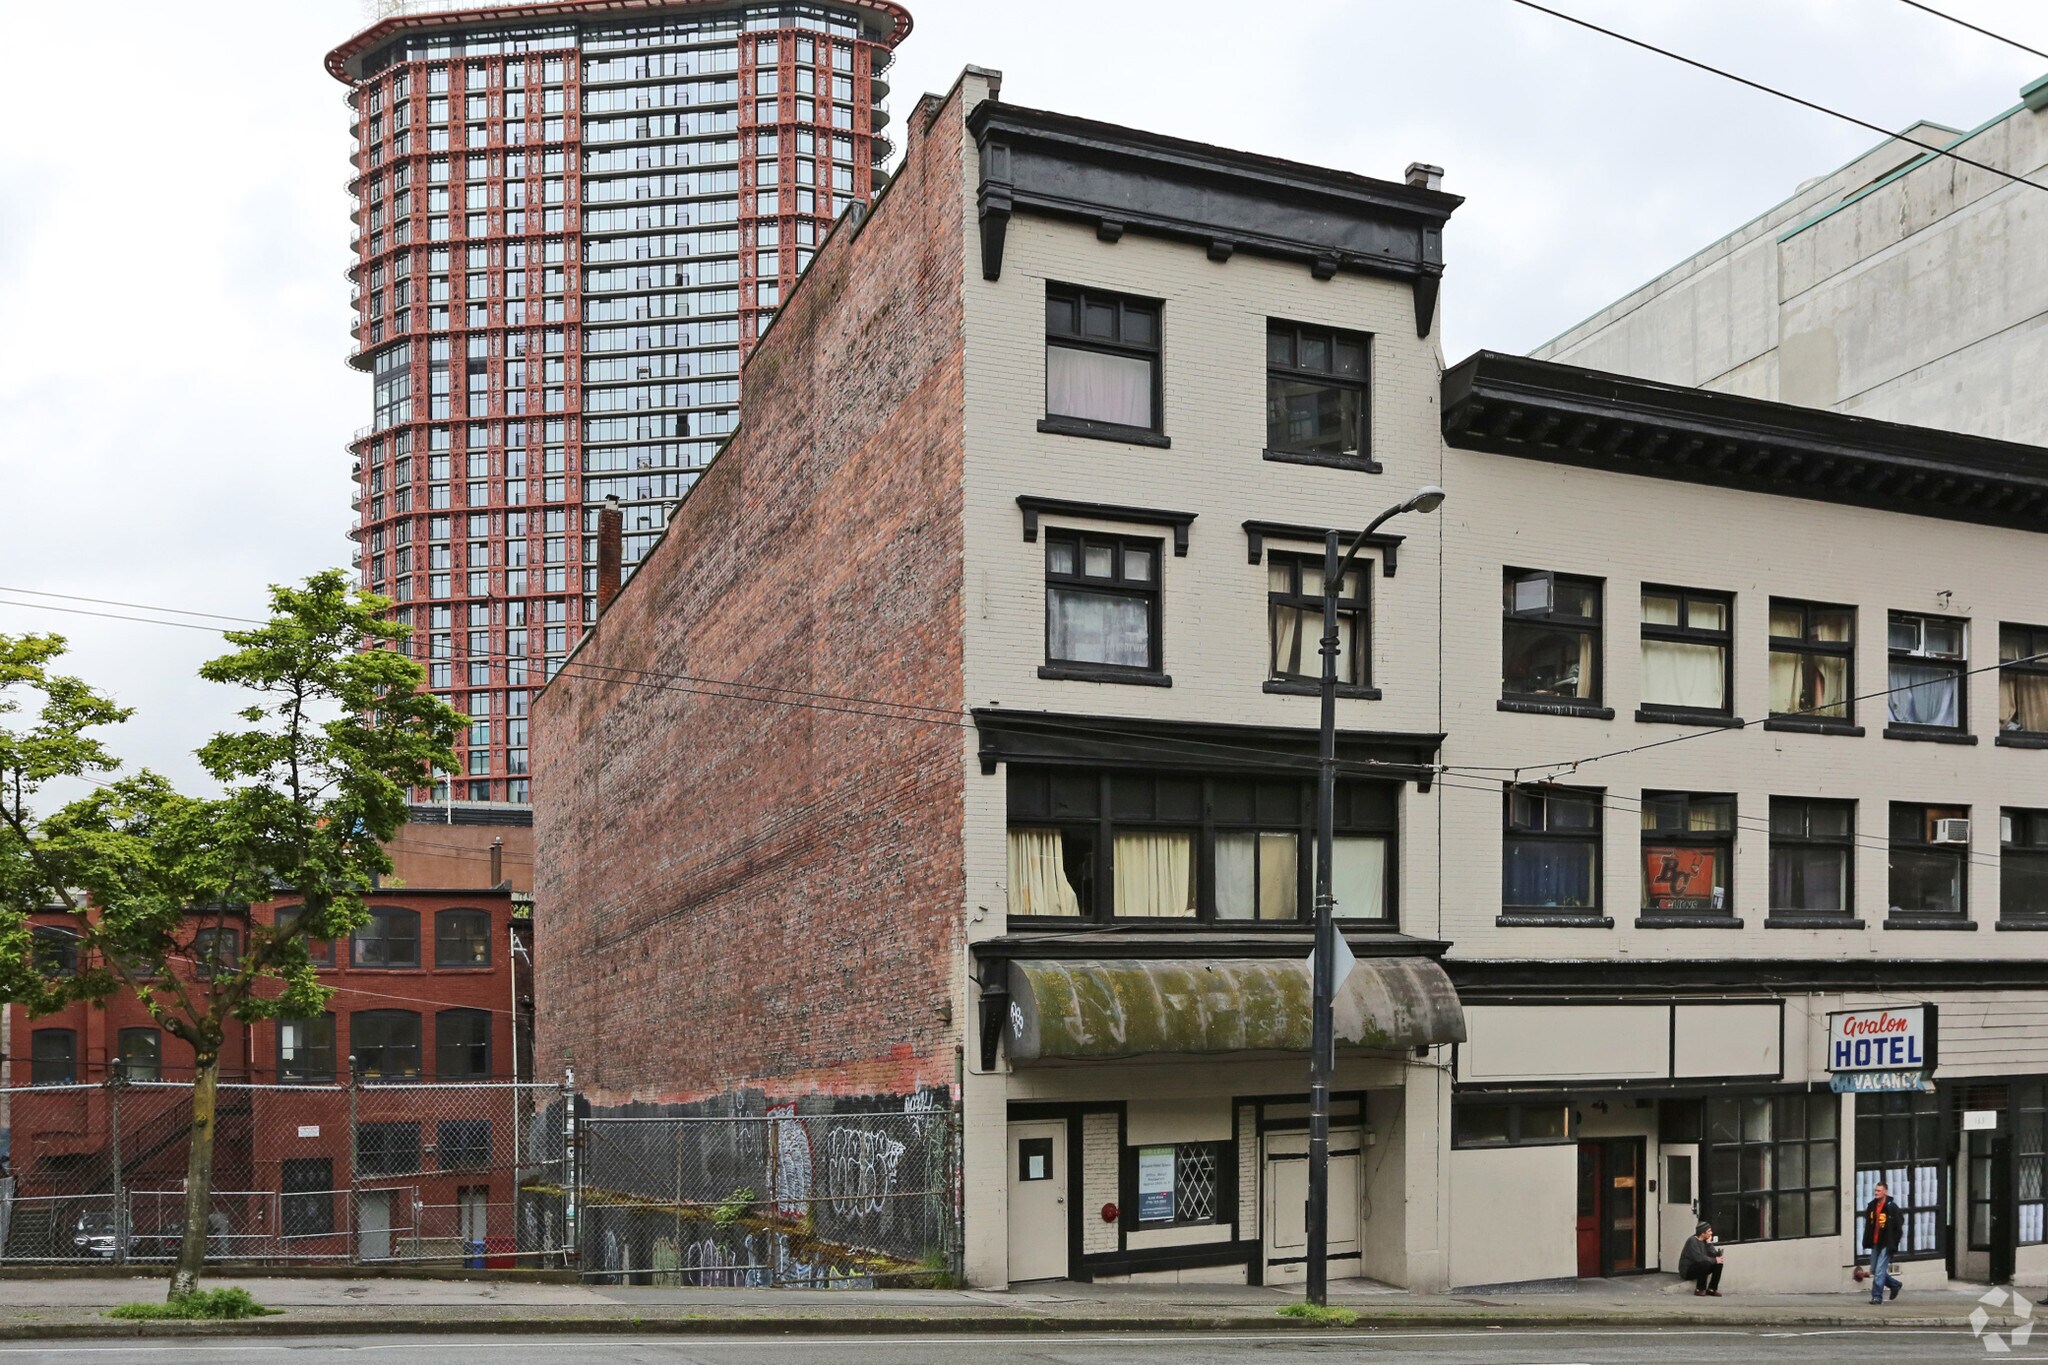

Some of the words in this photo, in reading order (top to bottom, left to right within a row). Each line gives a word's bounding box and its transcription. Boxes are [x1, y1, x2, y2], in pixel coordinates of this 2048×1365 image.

[1843, 1012, 1908, 1037] Avalon
[1836, 1036, 1921, 1067] HOTEL
[1854, 1072, 1920, 1089] VACANCY
